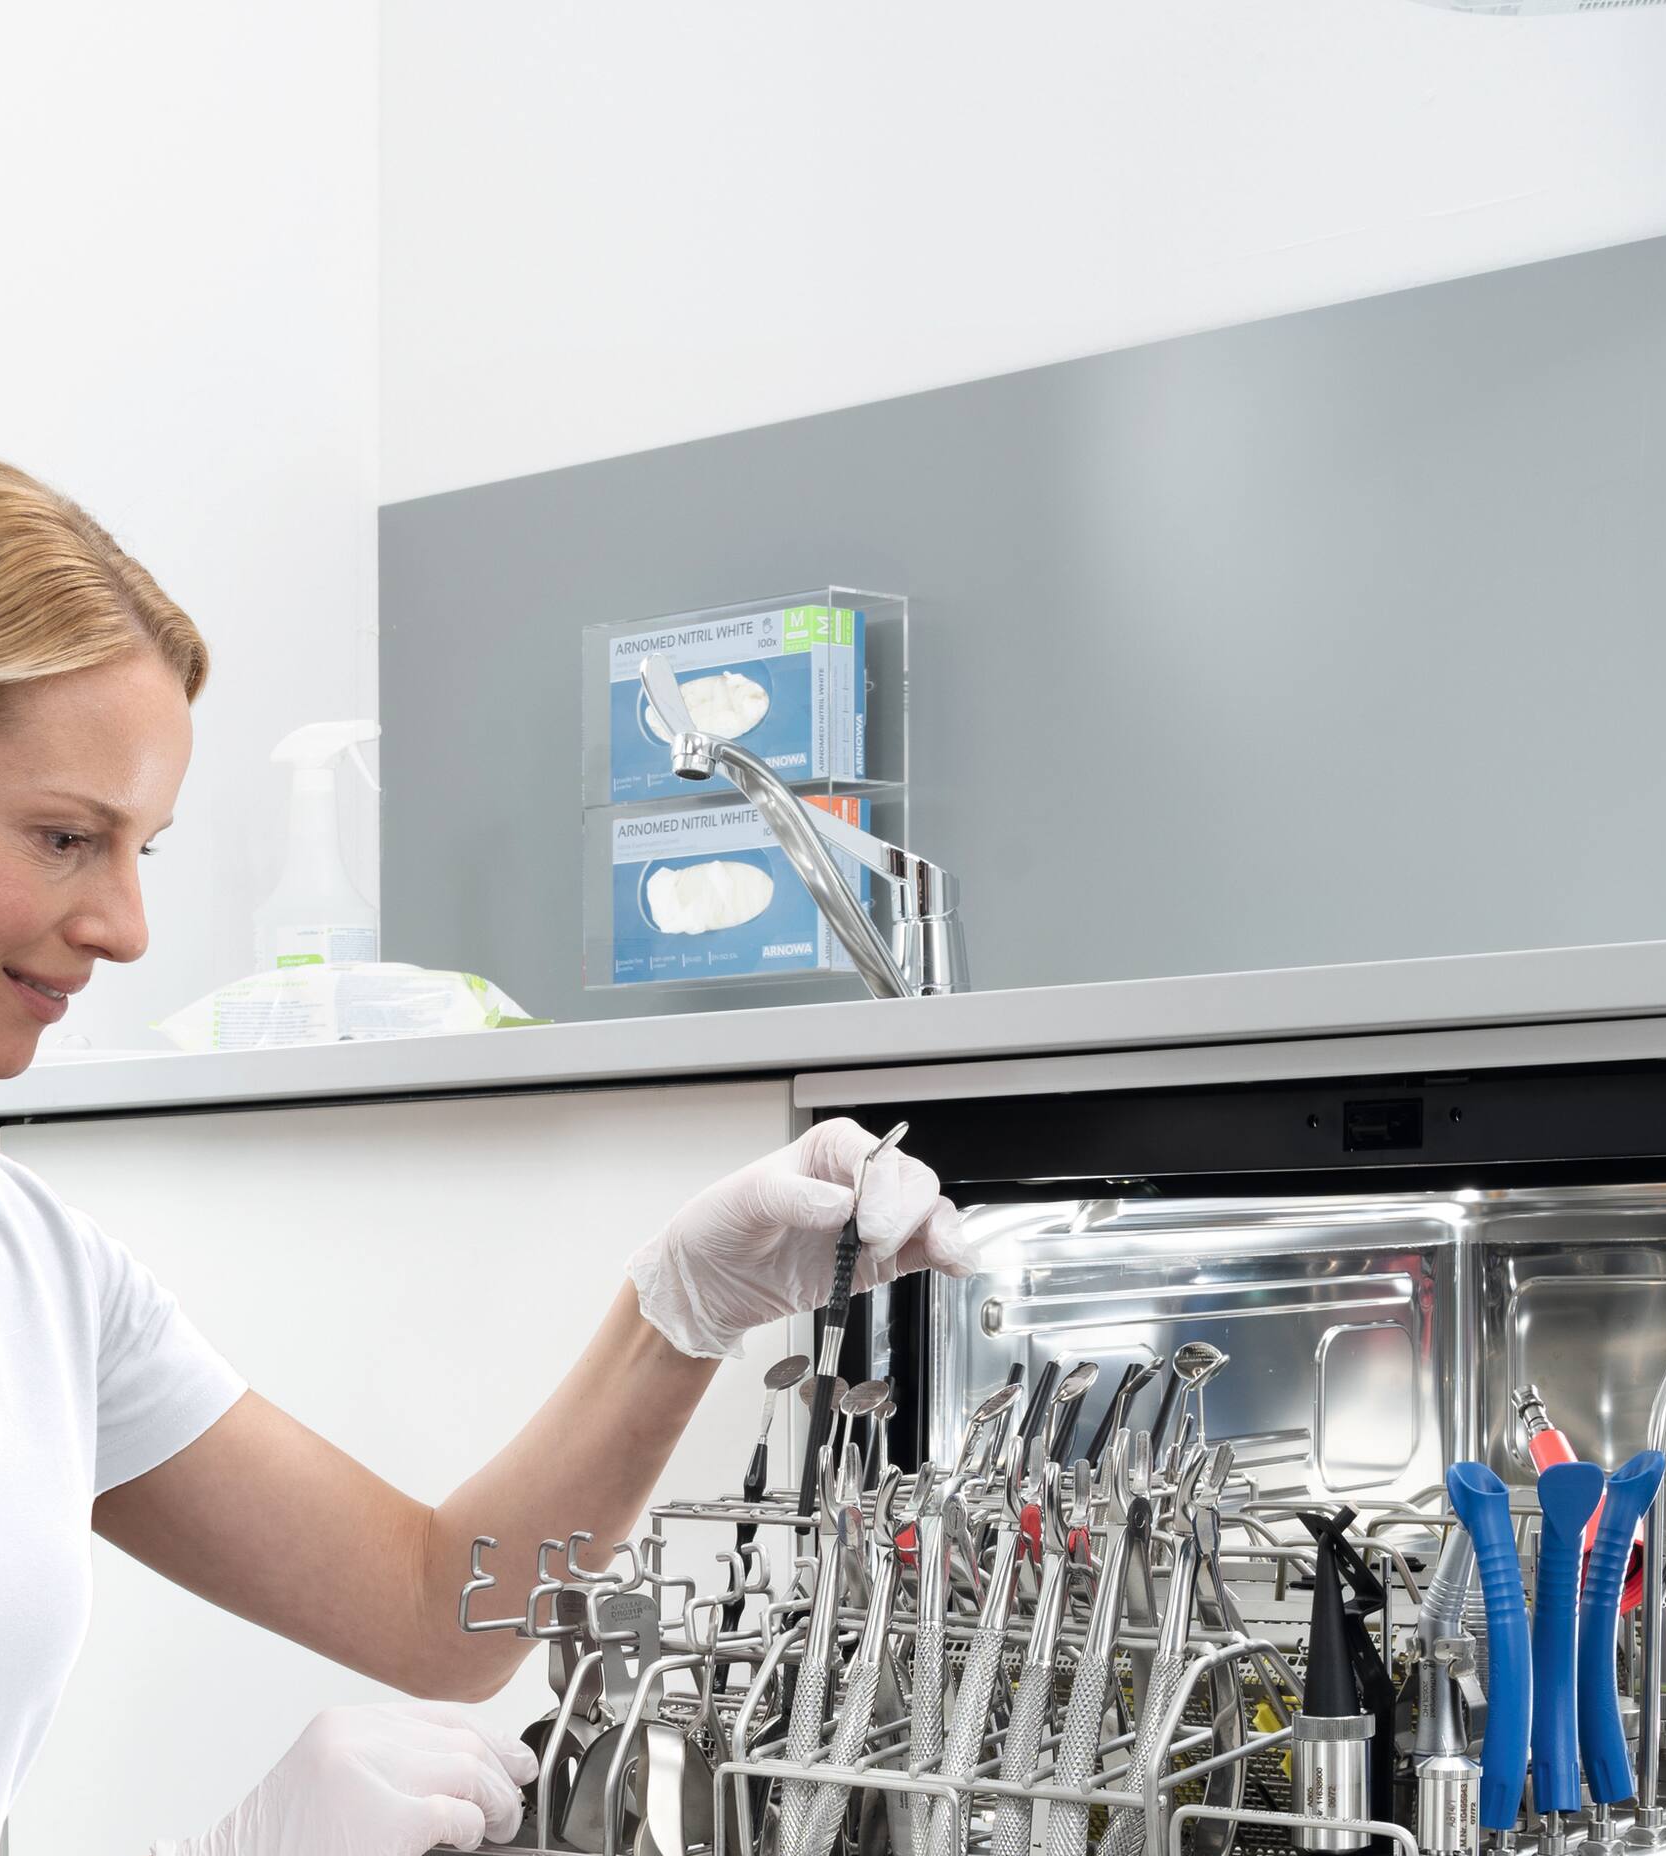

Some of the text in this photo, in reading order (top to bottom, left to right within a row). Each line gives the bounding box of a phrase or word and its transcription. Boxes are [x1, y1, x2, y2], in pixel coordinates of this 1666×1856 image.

[790, 609, 805, 628] M
[615, 621, 754, 656] ARNOMED NITRIL WHITE
[757, 637, 777, 649] 100x
[766, 753, 807, 768] RNOWA
[618, 809, 759, 838] ARNOMED NITRIL WHITE
[762, 943, 813, 958] ARNOWA
